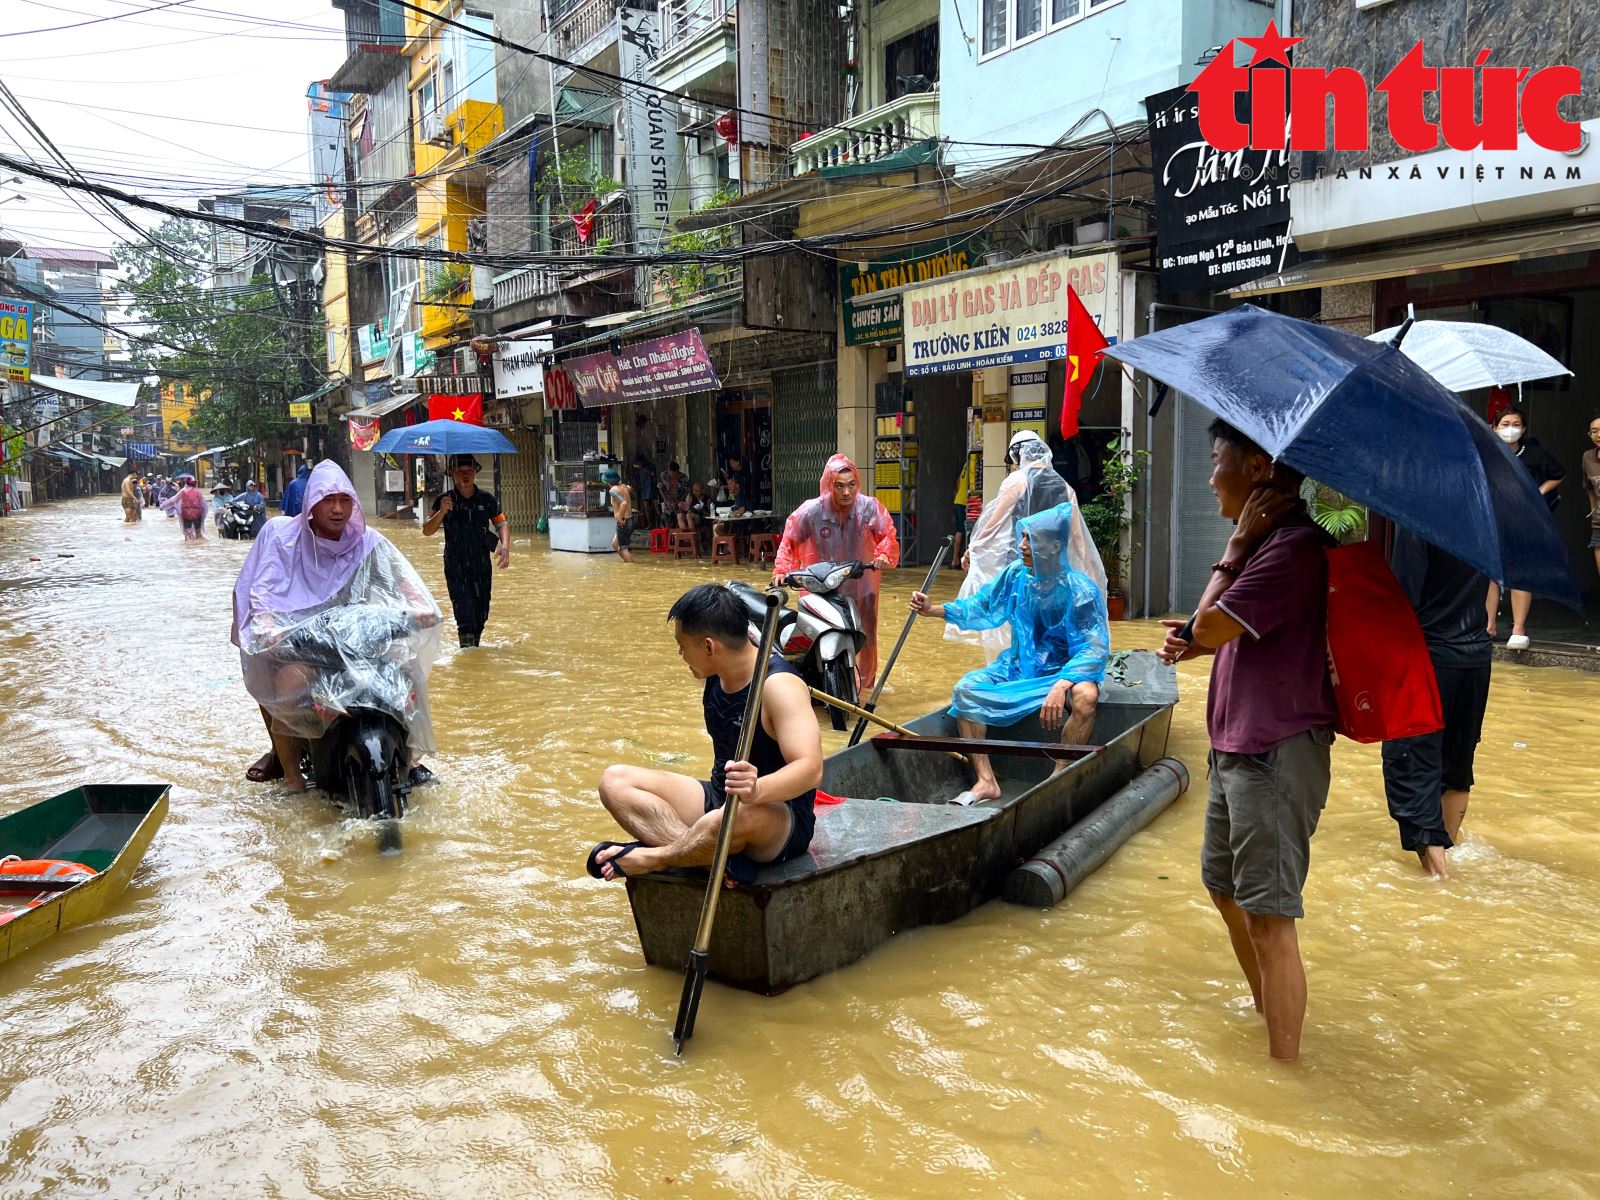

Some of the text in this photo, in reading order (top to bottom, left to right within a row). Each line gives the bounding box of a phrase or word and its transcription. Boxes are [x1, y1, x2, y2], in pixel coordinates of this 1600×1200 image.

[646, 94, 667, 150] QUÁN
[650, 155, 669, 224] STREET
[1243, 185, 1271, 210] Nối
[1199, 205, 1219, 221] Mẫu
[1220, 203, 1238, 216] Tóc
[1177, 254, 1198, 266] Trong
[1199, 249, 1214, 262] Ngõ
[1236, 241, 1252, 254] Bảo
[1253, 237, 1275, 250] Linh,
[1208, 254, 1271, 276] ĐT: 0916538548
[912, 262, 1106, 331] ĐẠI LÝ GAS VÀ BẾP GAS
[852, 305, 881, 328] CHUYÊN
[913, 320, 1068, 359] TRƯỜNG KIÊN 024 3828
[617, 357, 632, 371] Hát
[632, 356, 648, 368] Cho
[648, 351, 671, 365] Nhau
[921, 365, 930, 375] SỐ
[931, 366, 938, 374] 16
[942, 362, 956, 372] BẢO
[956, 361, 971, 370] LINH
[976, 358, 995, 367] HOÀN
[996, 355, 1013, 364] KIẾM
